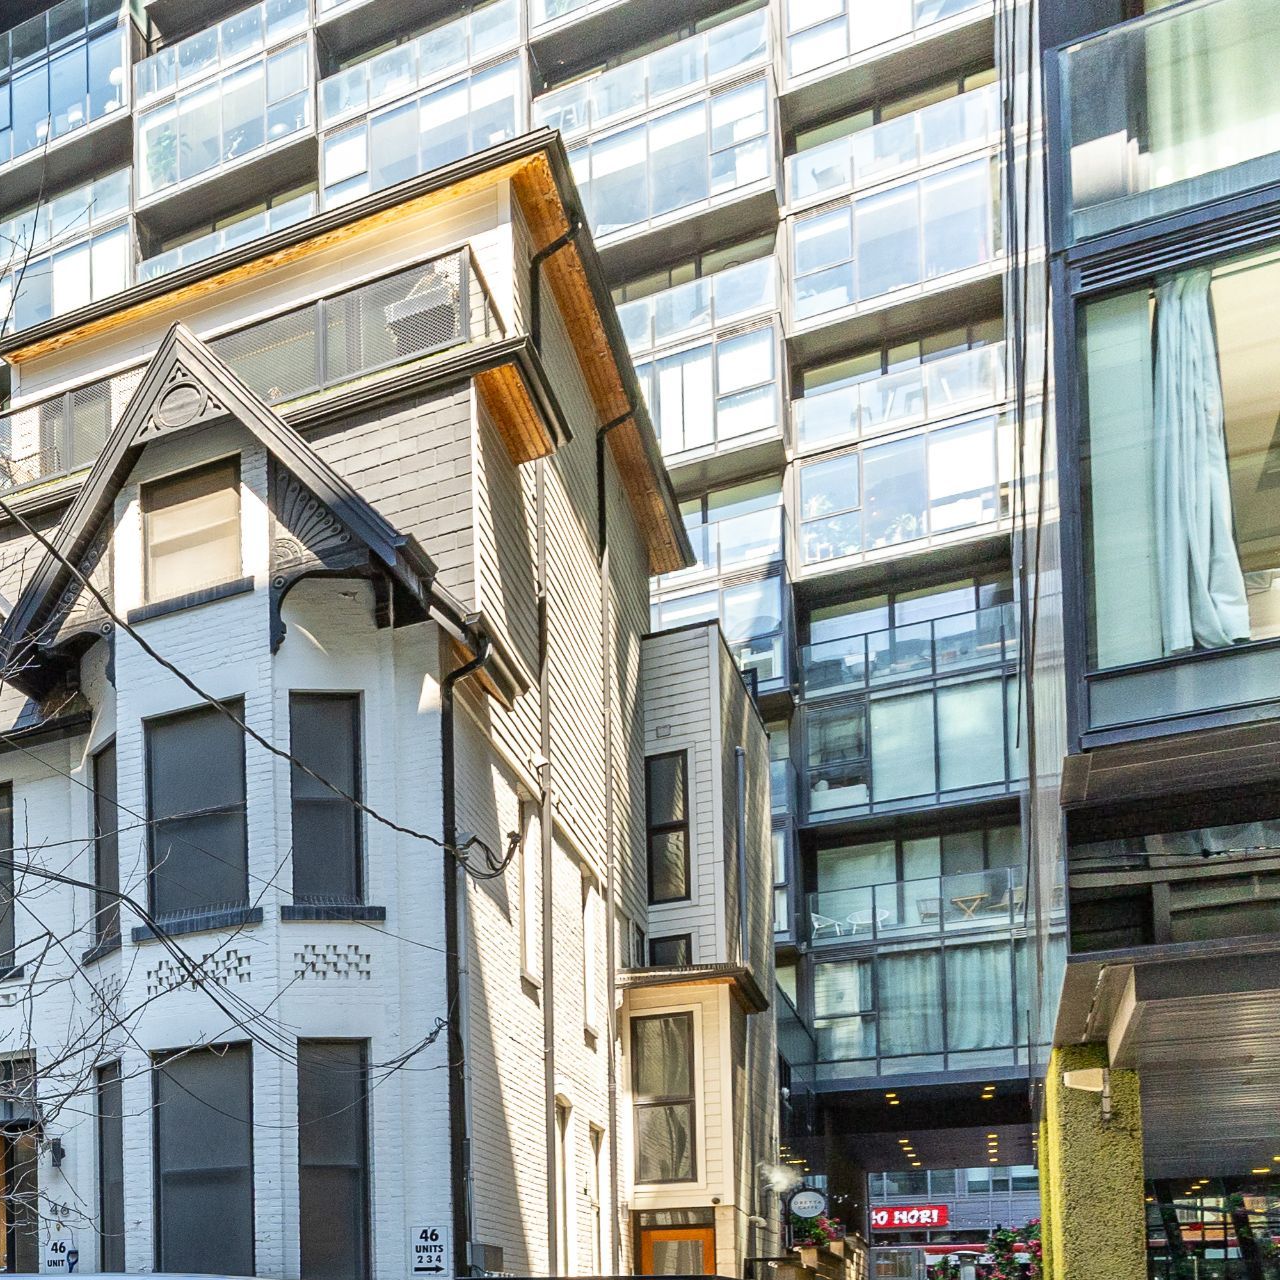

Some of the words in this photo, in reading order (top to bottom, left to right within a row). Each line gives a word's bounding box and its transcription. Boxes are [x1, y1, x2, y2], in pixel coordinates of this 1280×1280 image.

[50, 1202, 70, 1217] 46
[420, 1229, 439, 1242] 46
[51, 1241, 66, 1254] 46
[415, 1245, 444, 1253] UNITS
[417, 1255, 424, 1264] 2
[426, 1255, 433, 1264] 3
[435, 1255, 442, 1263] 4
